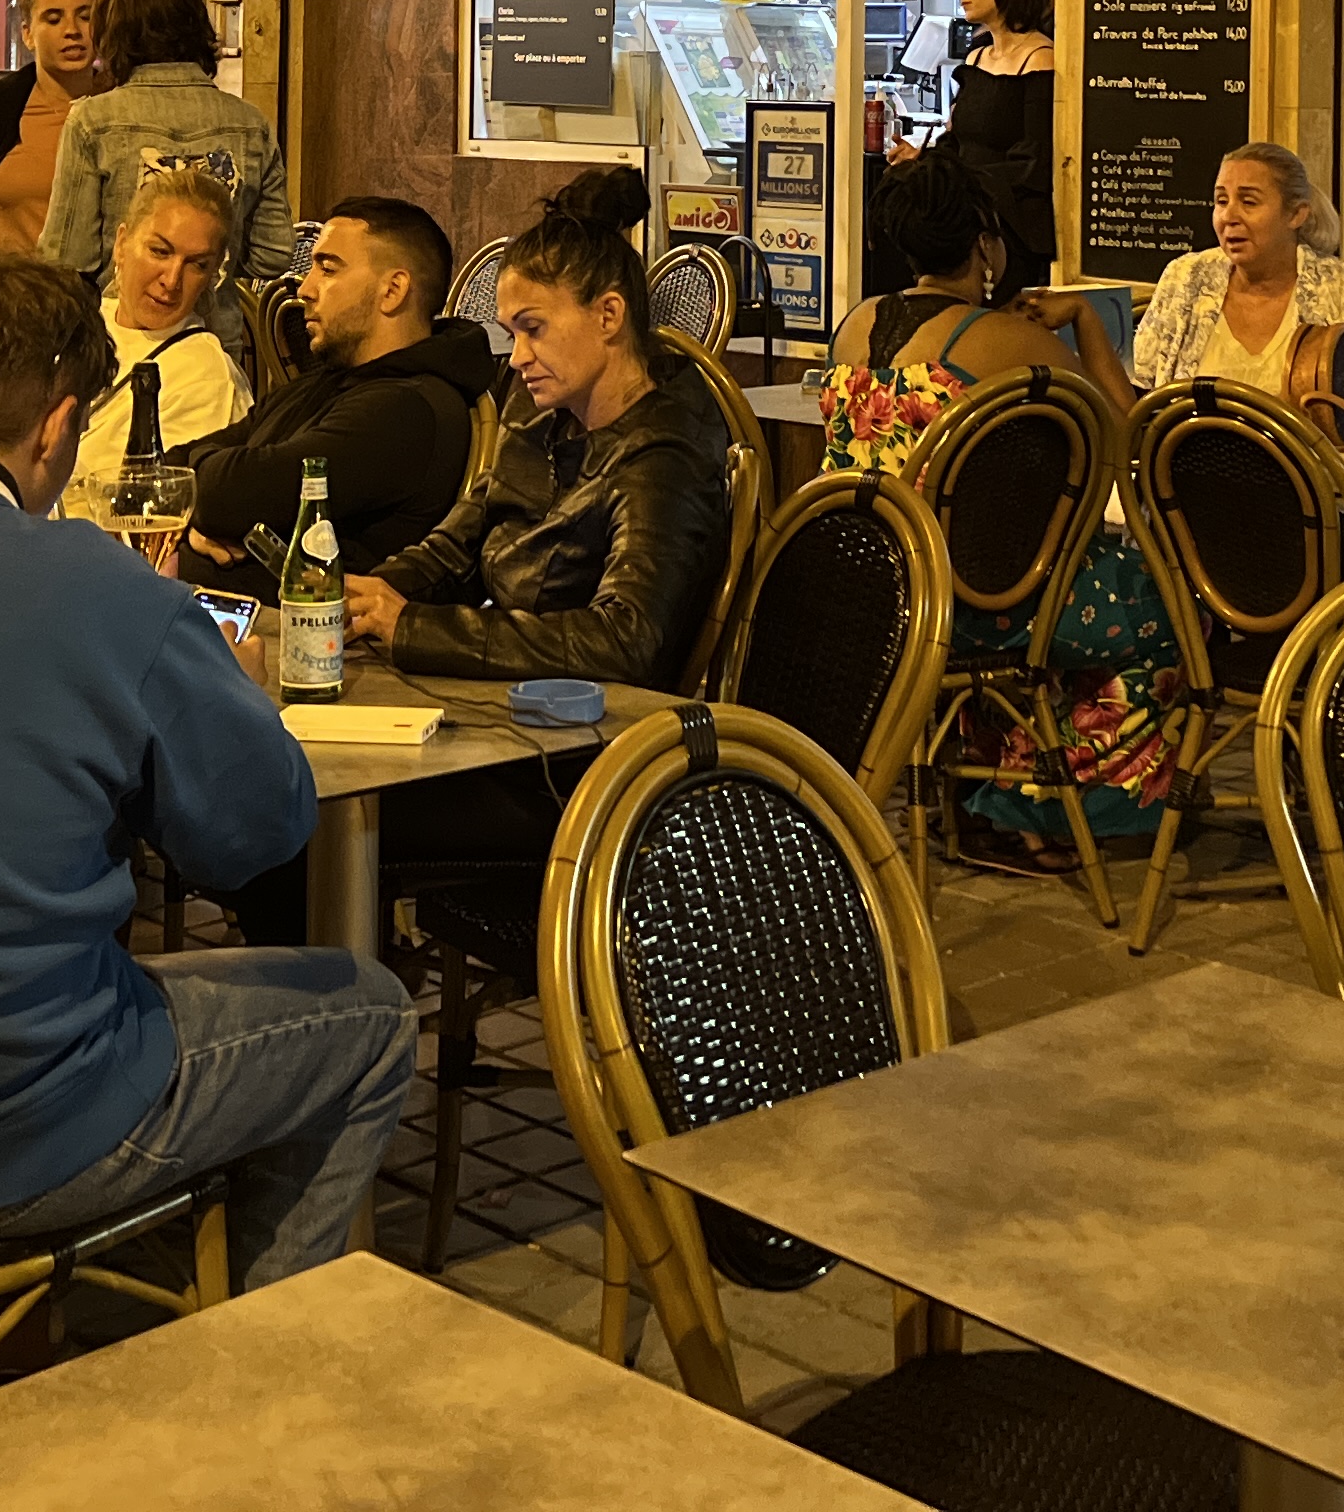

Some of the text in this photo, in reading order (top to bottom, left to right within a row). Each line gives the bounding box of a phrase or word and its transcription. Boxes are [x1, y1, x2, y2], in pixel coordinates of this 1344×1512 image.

[1099, 26, 1137, 39] Travers
[1142, 27, 1154, 39] de
[1157, 26, 1178, 39] Porc
[784, 156, 805, 175] 27
[761, 181, 810, 195] MILLIONS
[784, 266, 794, 286] 5
